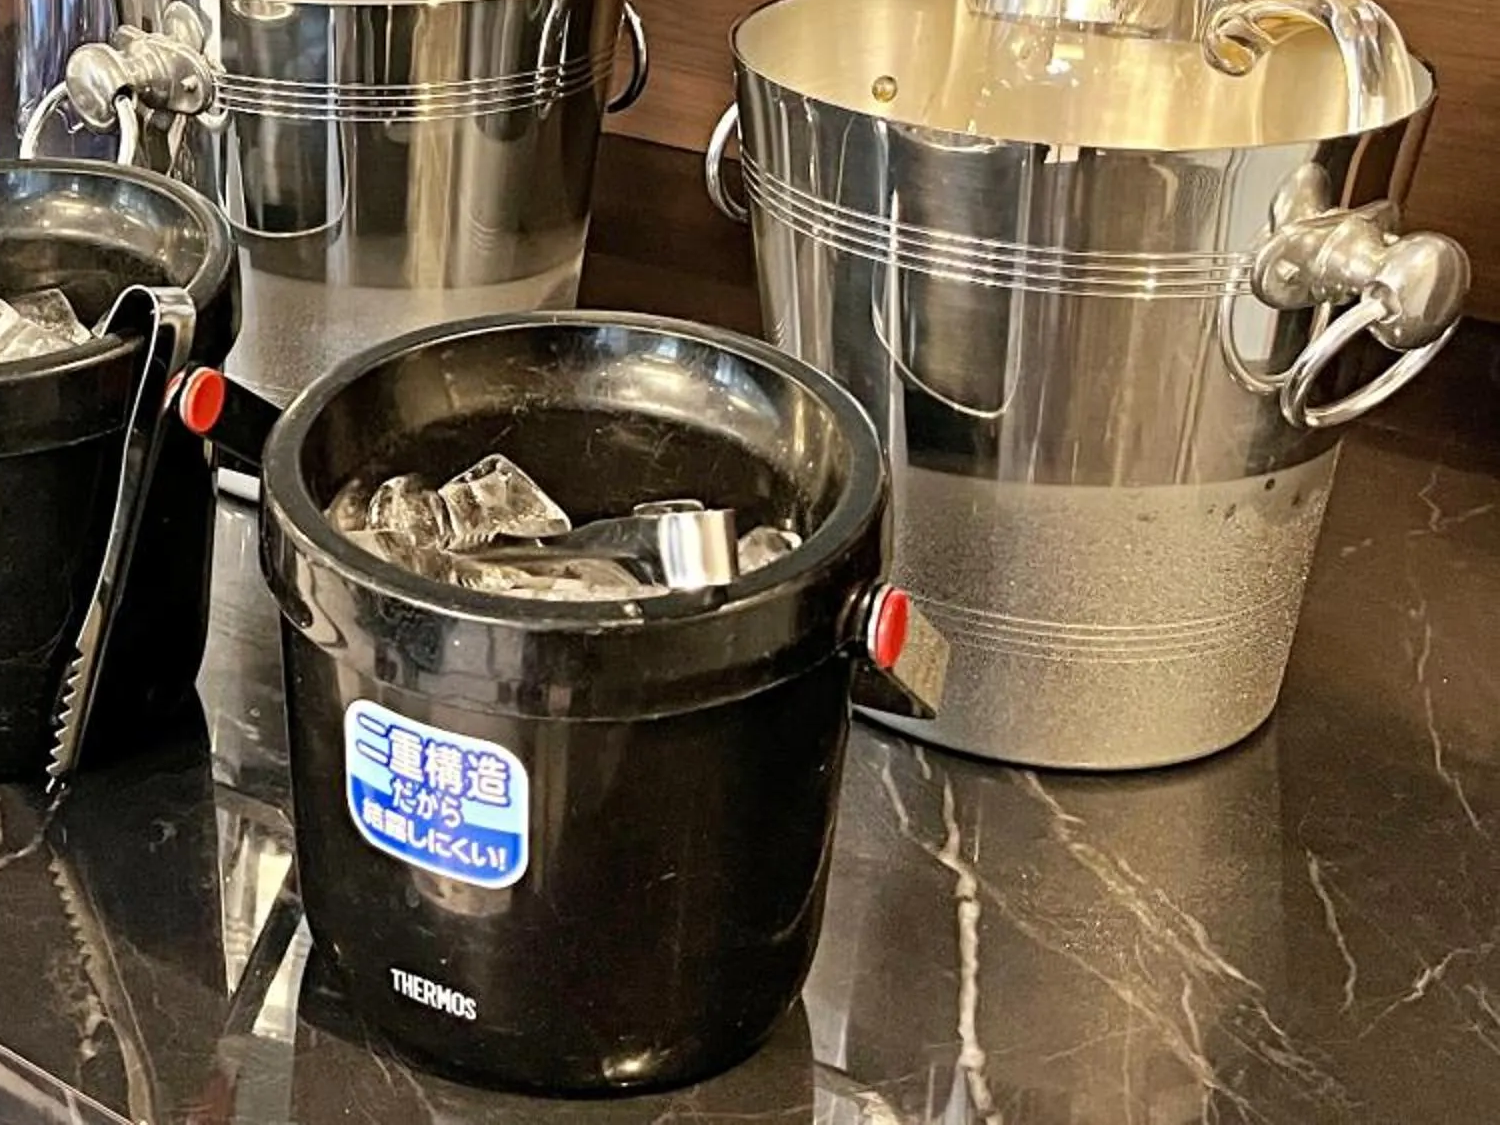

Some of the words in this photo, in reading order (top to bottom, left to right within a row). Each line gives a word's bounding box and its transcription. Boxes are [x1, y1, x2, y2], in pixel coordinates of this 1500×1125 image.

[356, 712, 513, 807] 二重構造
[389, 777, 464, 829] だから
[389, 967, 477, 1020] THERMOS
